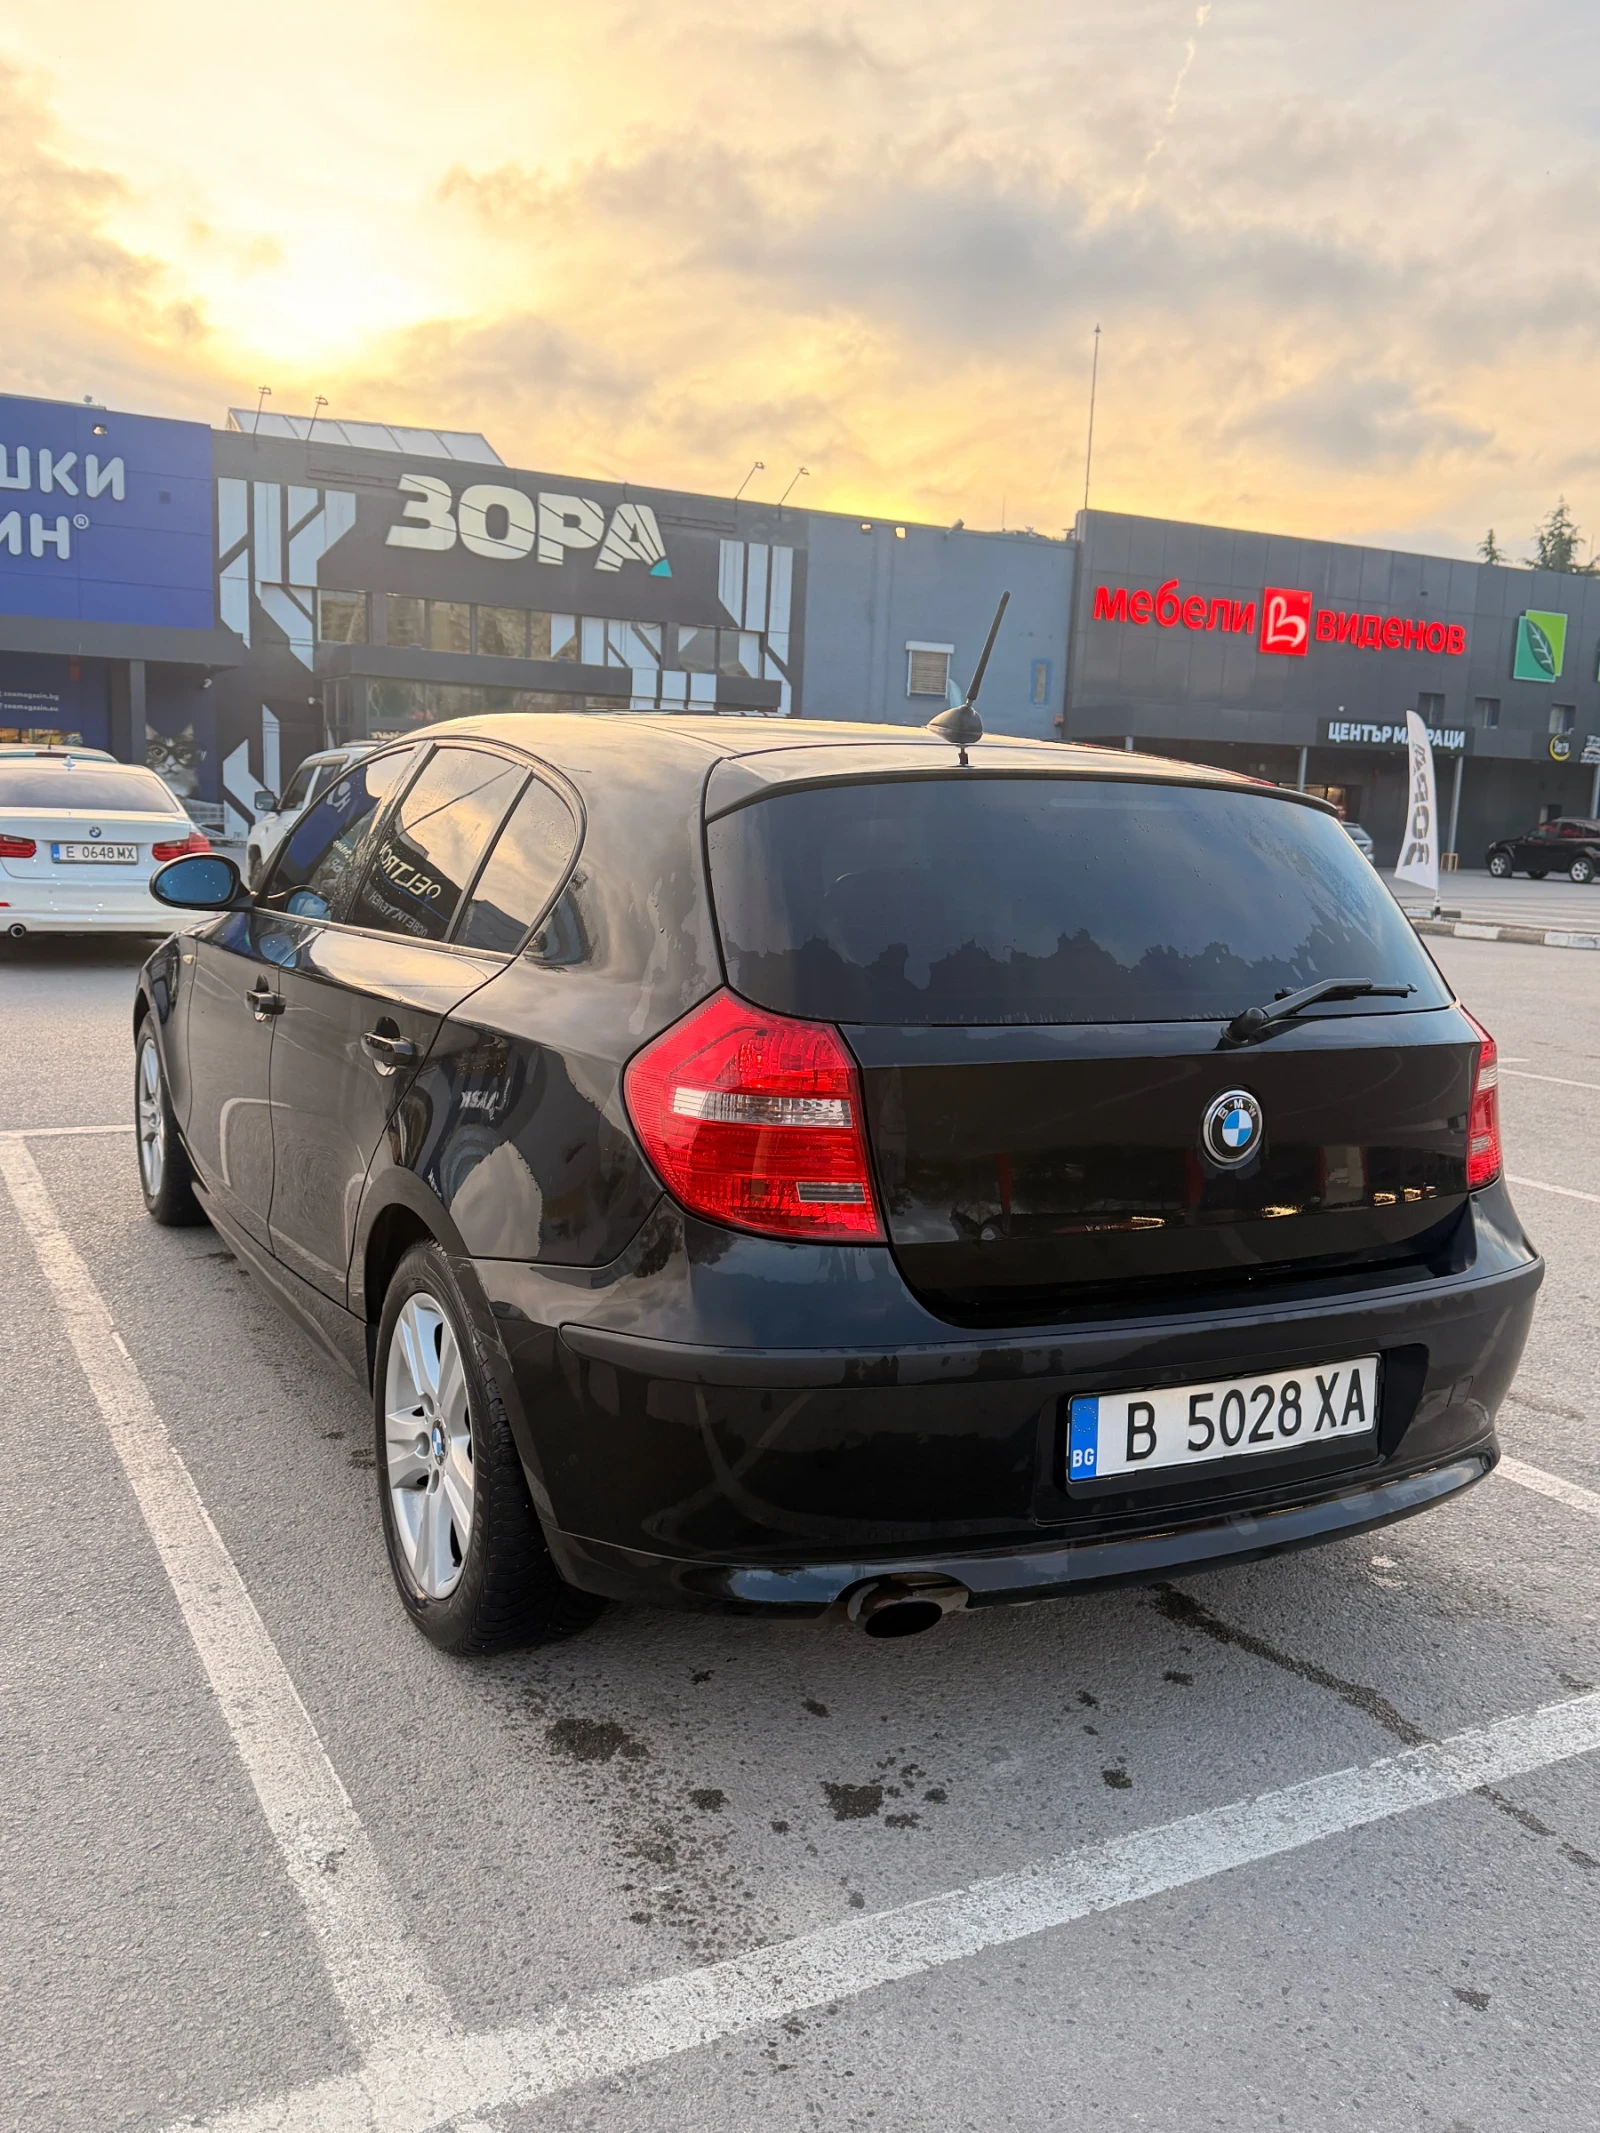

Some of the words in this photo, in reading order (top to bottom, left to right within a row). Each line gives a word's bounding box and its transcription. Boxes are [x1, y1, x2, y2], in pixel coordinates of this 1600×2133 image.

[385, 473, 672, 577] ЗОРА
[1328, 721, 1394, 744] ЦЕНТЪР
[1392, 726, 1466, 750] МРАЦИ
[66, 845, 76, 859] E
[82, 846, 115, 859] 0648
[1126, 1401, 1157, 1462] B
[1187, 1379, 1302, 1452] 5028
[1313, 1367, 1366, 1432] XA
[1072, 1448, 1095, 1468] BG
